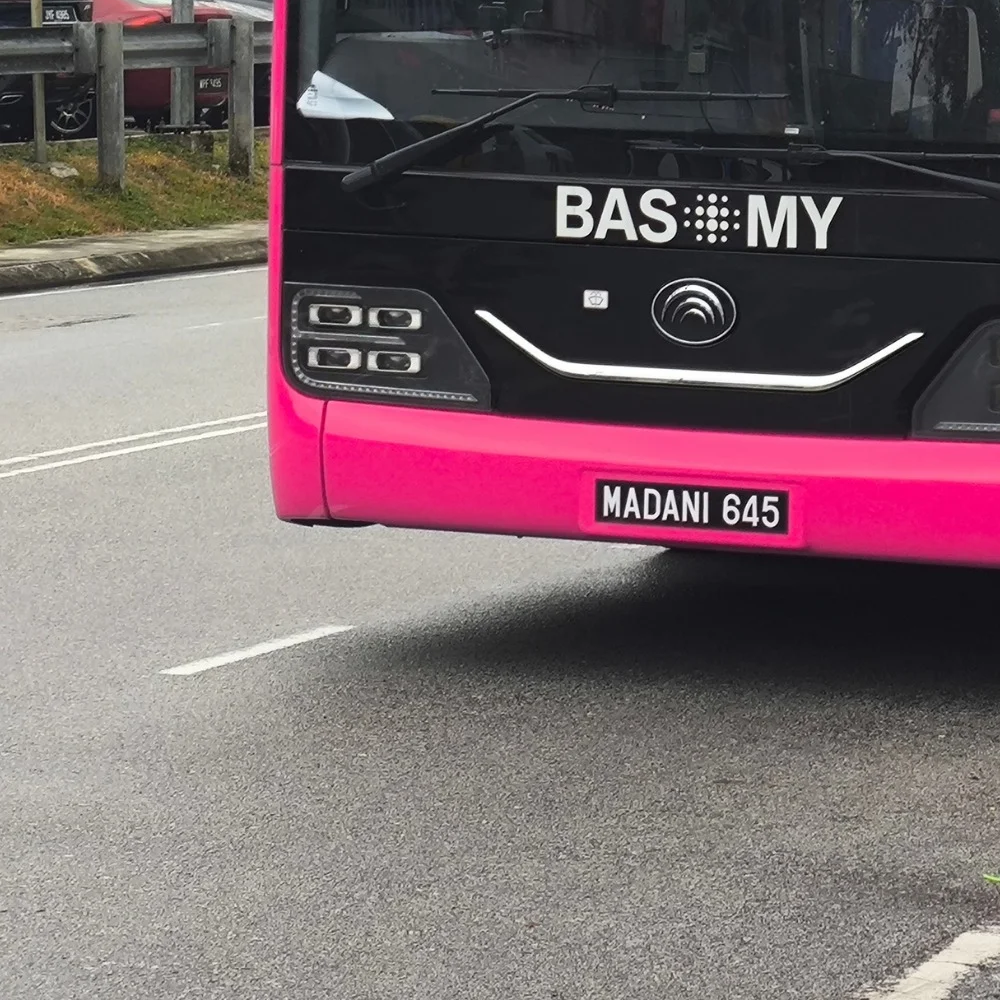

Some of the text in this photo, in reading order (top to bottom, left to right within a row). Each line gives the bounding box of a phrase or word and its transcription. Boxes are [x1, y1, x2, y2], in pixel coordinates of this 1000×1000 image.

[556, 185, 843, 249] BAS MY
[603, 485, 780, 528] MADANI 645
